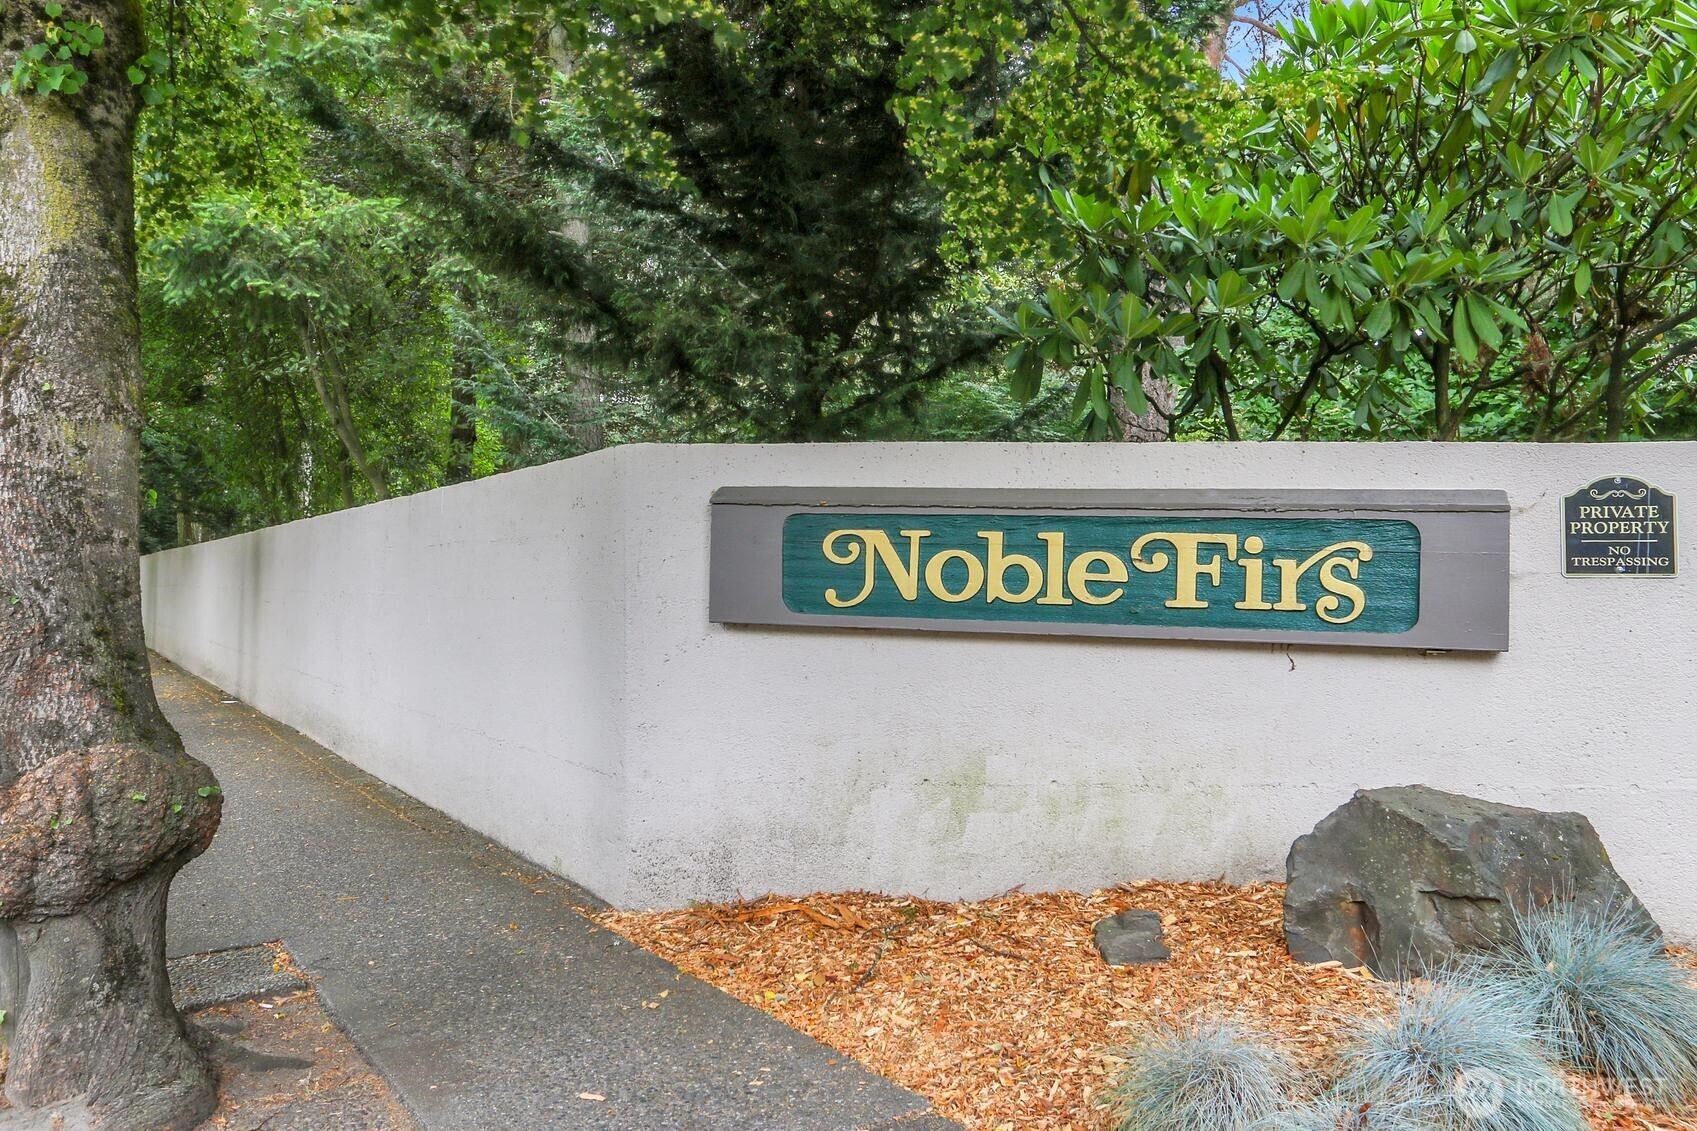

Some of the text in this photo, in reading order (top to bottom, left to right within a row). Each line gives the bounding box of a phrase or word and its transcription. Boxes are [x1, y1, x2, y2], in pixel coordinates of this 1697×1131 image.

[1579, 505, 1660, 518] PRIVATE
[1570, 521, 1669, 534] PROPERTY
[1608, 546, 1631, 555] NO
[1571, 557, 1669, 566] TRESPASSING
[823, 529, 1373, 623] Noble Firs
